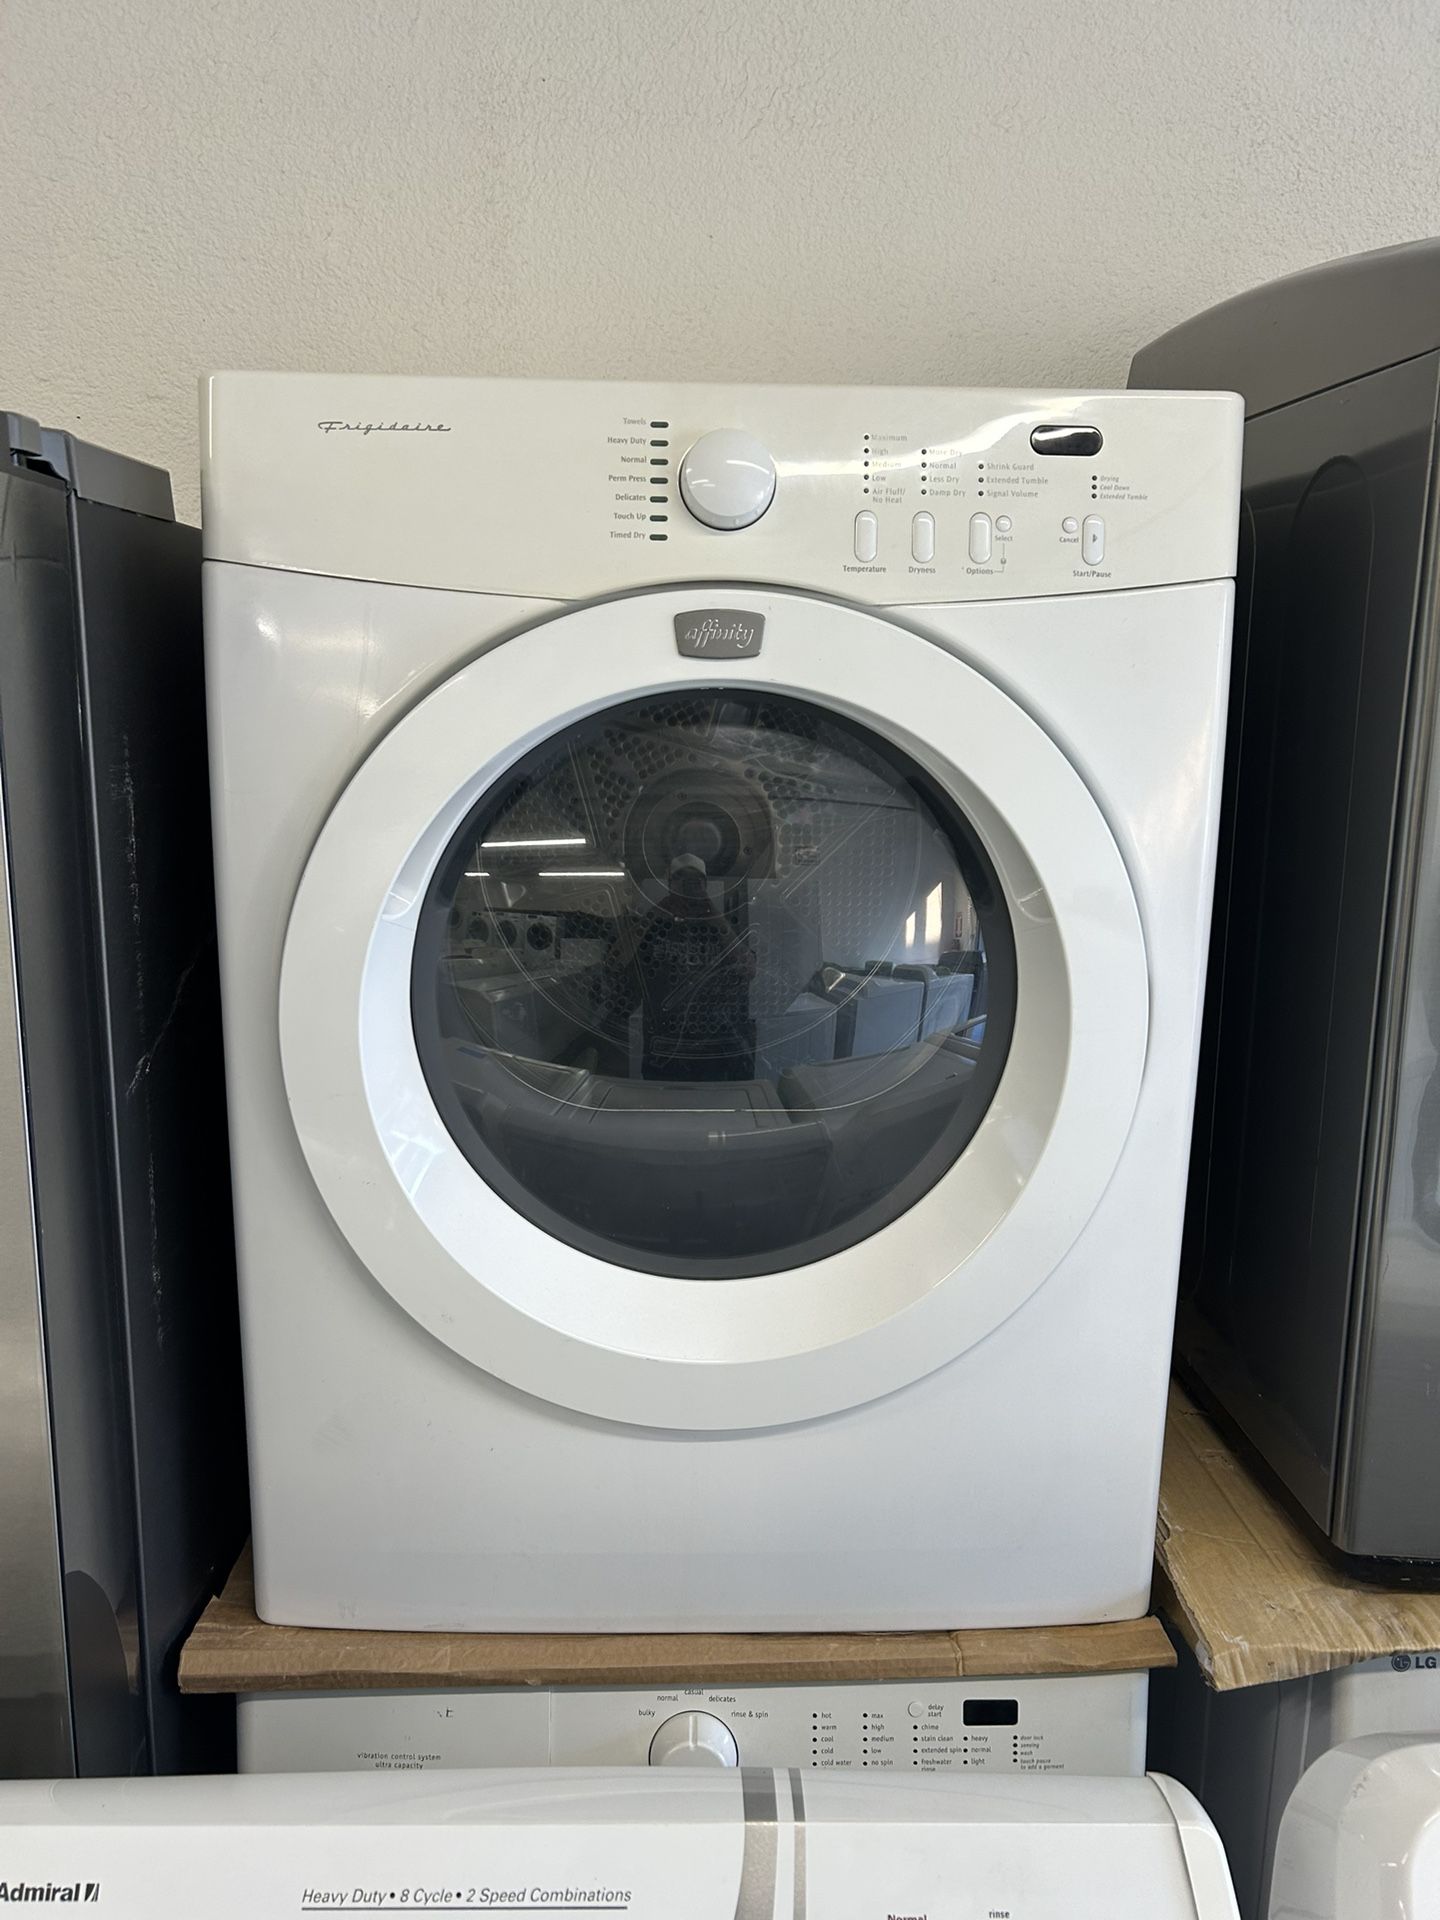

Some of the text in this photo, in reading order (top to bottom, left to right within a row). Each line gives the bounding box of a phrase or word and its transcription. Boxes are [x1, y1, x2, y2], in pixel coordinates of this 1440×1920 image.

[623, 417, 647, 425] Towels
[318, 420, 451, 436] Frigidaire
[607, 436, 647, 446] Heavy Duty
[871, 434, 907, 442] Maximum
[872, 447, 889, 456] High
[621, 456, 647, 464] Normal
[929, 461, 957, 469] Normal
[987, 462, 1034, 471] Shrink Guard
[608, 474, 647, 483] Perm Press
[872, 474, 887, 482] Low
[929, 474, 960, 484] Less Dry
[987, 475, 1049, 485] Extended Tumble
[1100, 475, 1119, 483] Drying
[872, 488, 883, 496] Air
[929, 488, 966, 497] Damp Dry
[987, 489, 1039, 498] Signal Volume
[615, 493, 647, 502] Delicates
[613, 512, 647, 522] Touch Up
[610, 531, 646, 541] Timed Dry
[995, 534, 1013, 542] Select
[843, 565, 887, 574] Temperature
[908, 566, 936, 575] Dryness
[966, 567, 994, 577] Options
[1073, 570, 1111, 578] Start/Pause
[684, 618, 754, 649] affinity
[1415, 1656, 1437, 1669] LG
[656, 1694, 679, 1702] normal
[708, 1694, 737, 1702] delicates
[638, 1708, 656, 1717] bulky
[748, 1710, 754, 1718] &
[755, 1711, 769, 1719] spin
[871, 1724, 885, 1732] high
[971, 1735, 988, 1743] heavy
[921, 1746, 948, 1754] extended
[357, 1752, 388, 1760] vibration
[394, 1762, 423, 1770] capacity
[821, 1758, 834, 1766] cold
[880, 1758, 894, 1767] spin
[921, 1758, 952, 1766] freshwater
[971, 1758, 985, 1766] light
[0, 1882, 81, 1902] Admiral
[302, 1887, 632, 1905] Heavy Duty 8 Cycle 2 Speed Combinations
[988, 1909, 1010, 1919] rinse
